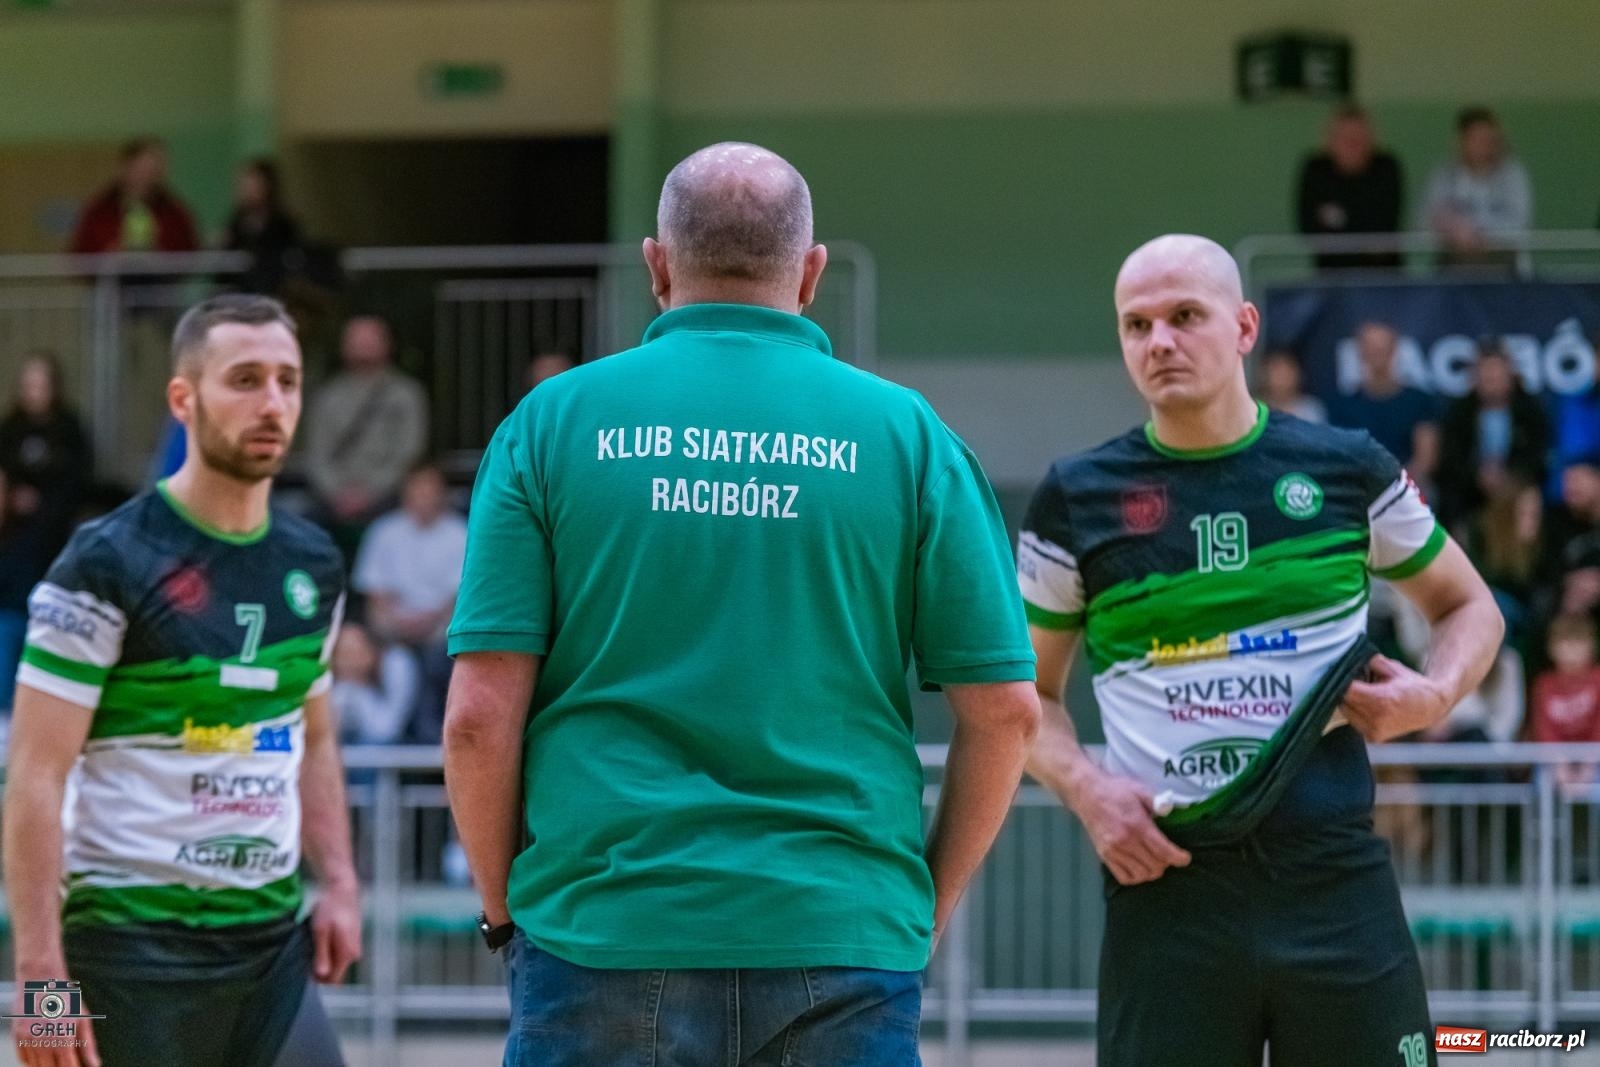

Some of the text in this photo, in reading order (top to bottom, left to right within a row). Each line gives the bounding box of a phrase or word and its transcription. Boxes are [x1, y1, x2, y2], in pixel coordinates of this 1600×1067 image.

[597, 426, 857, 473] KLUB SIATKARSKI
[651, 477, 799, 518] RACIBÓRZ
[1190, 512, 1249, 573] 19
[234, 603, 266, 663] 7
[1164, 674, 1292, 704] PIVEXIN
[1168, 701, 1292, 722] TECHNOLOGY
[1398, 1032, 1428, 1067] 19
